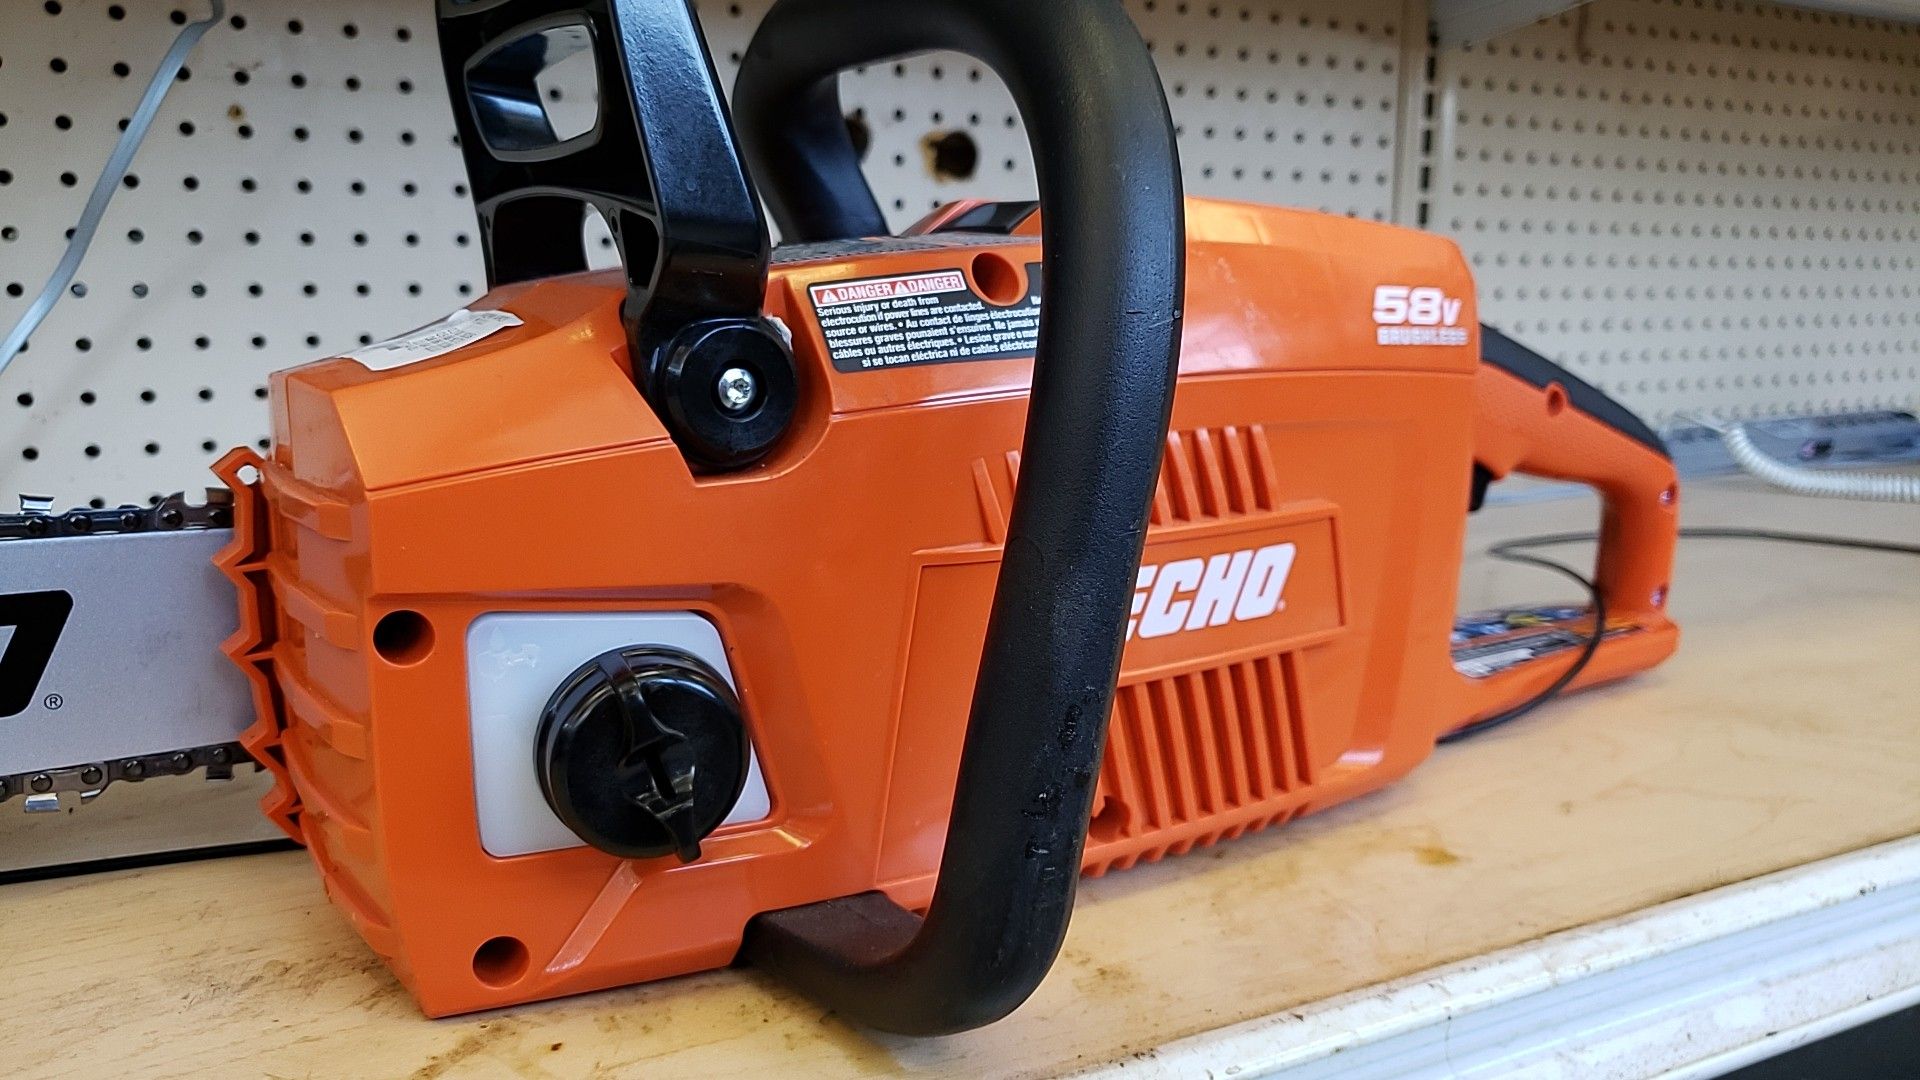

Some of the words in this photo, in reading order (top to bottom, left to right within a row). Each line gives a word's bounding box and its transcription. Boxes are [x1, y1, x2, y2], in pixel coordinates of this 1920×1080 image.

[837, 283, 893, 300] DANGER
[907, 276, 962, 295] DANGER
[817, 306, 852, 317] Serious
[853, 303, 879, 313] injury
[892, 298, 917, 308] death
[918, 296, 939, 305] from
[821, 313, 877, 327] electrocution
[877, 311, 884, 320] if
[884, 310, 910, 321] power
[910, 307, 930, 316] lines
[930, 306, 944, 314] are
[944, 301, 985, 313] contacted.
[825, 327, 856, 337] source
[858, 325, 867, 333] or
[870, 322, 897, 332] wires.
[906, 319, 918, 328] Au
[920, 315, 951, 327] contact
[952, 315, 963, 323] de
[829, 336, 873, 349] blessures
[874, 333, 904, 345] graves
[1007, 318, 1034, 330] jamais
[862, 357, 871, 367] si
[872, 357, 884, 366] se
[884, 354, 910, 364] tocan
[949, 347, 958, 357] ni
[960, 347, 970, 355] de
[972, 343, 999, 354] cables
[864, 347, 876, 355] ou
[878, 343, 906, 354] autres
[993, 331, 1016, 342] grave
